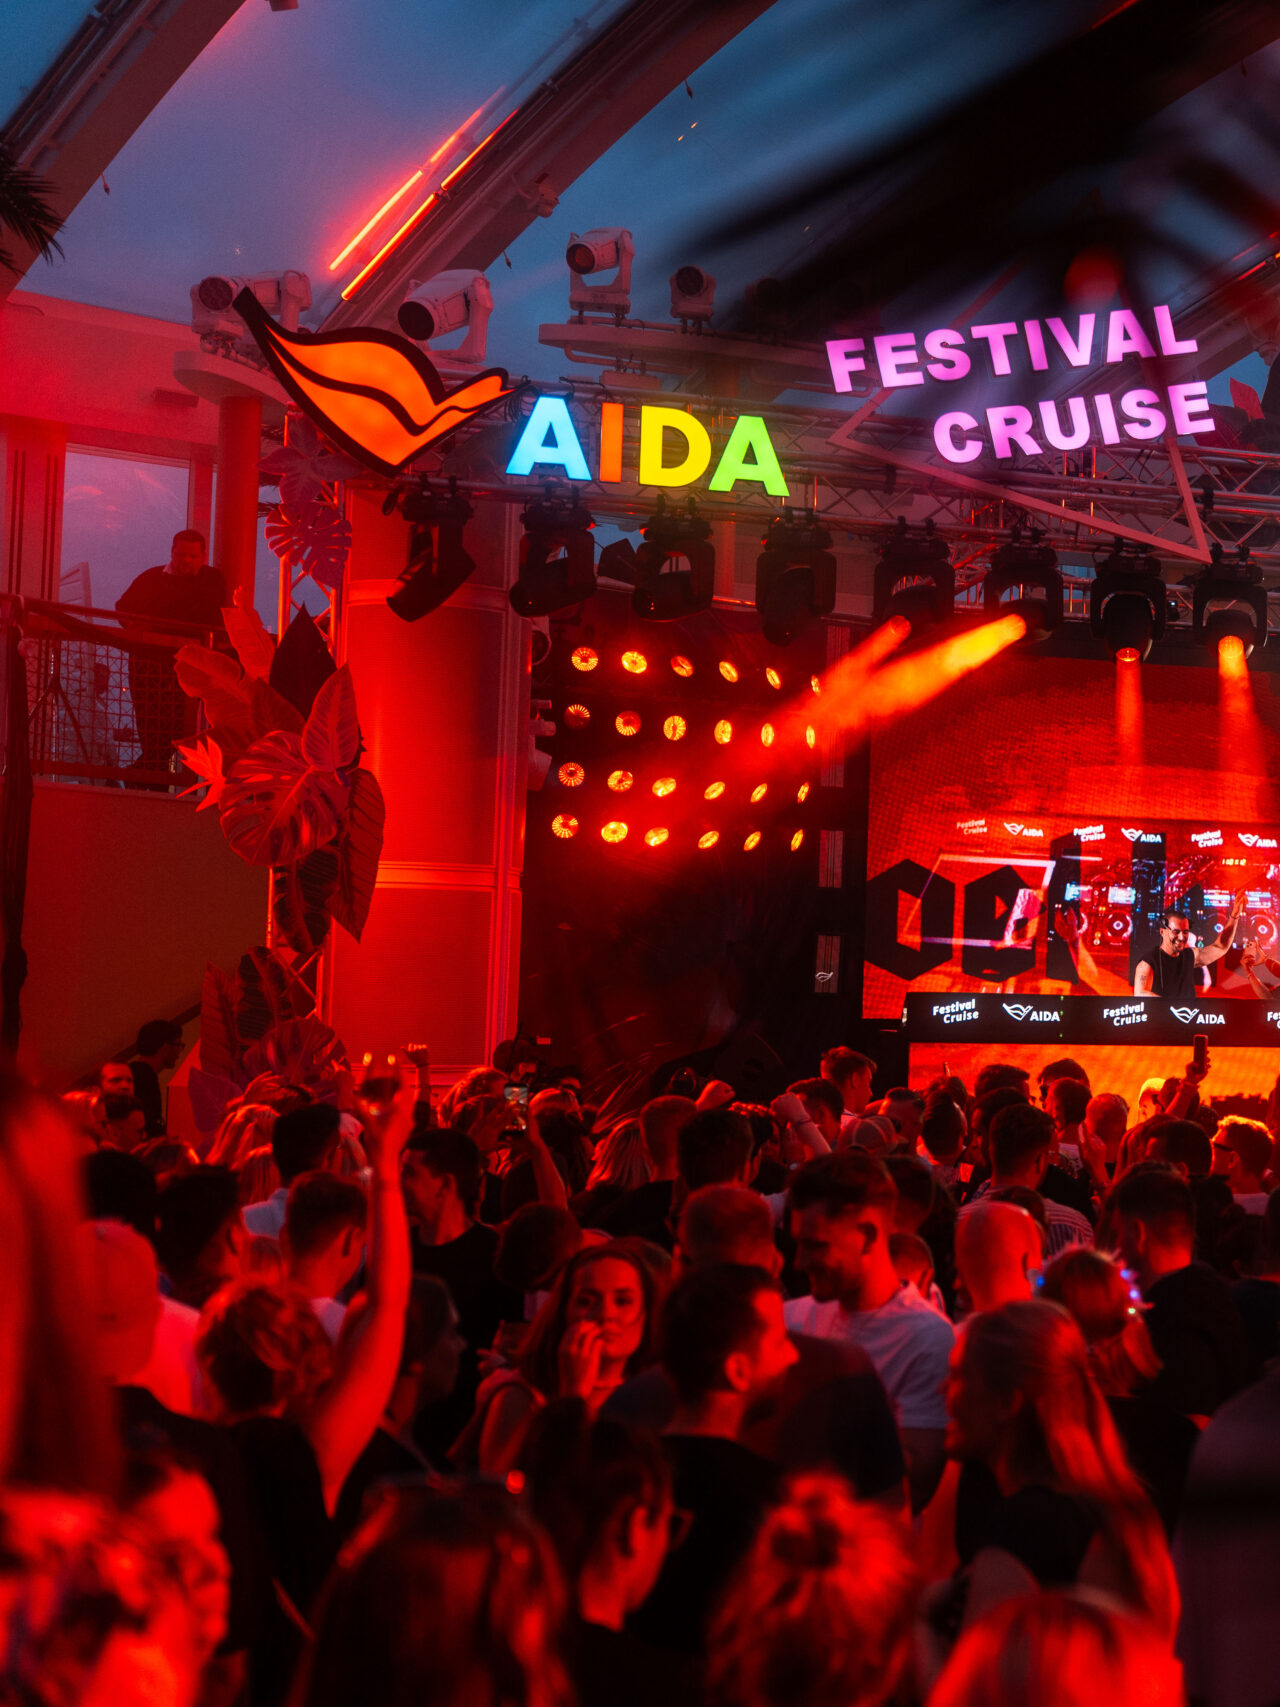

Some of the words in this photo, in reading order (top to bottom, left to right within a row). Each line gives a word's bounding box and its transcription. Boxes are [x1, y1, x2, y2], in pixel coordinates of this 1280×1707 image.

[825, 304, 1199, 393] FESTIVAL
[933, 381, 1216, 464] CRUISE
[505, 396, 790, 497] AIDA
[1073, 824, 1104, 836] Festival
[1191, 830, 1222, 842] Festival
[1080, 832, 1106, 842] Cruise
[1140, 833, 1162, 843] AIDA
[1198, 837, 1223, 848] Cruise
[1256, 838, 1278, 848] AIDA
[932, 999, 976, 1016] Festival
[1103, 1002, 1145, 1018] Festival
[943, 1010, 979, 1024] Cruise
[1029, 1010, 1061, 1022] AIDA
[1113, 1013, 1148, 1027] Cruise
[1196, 1013, 1226, 1025] AIDA
